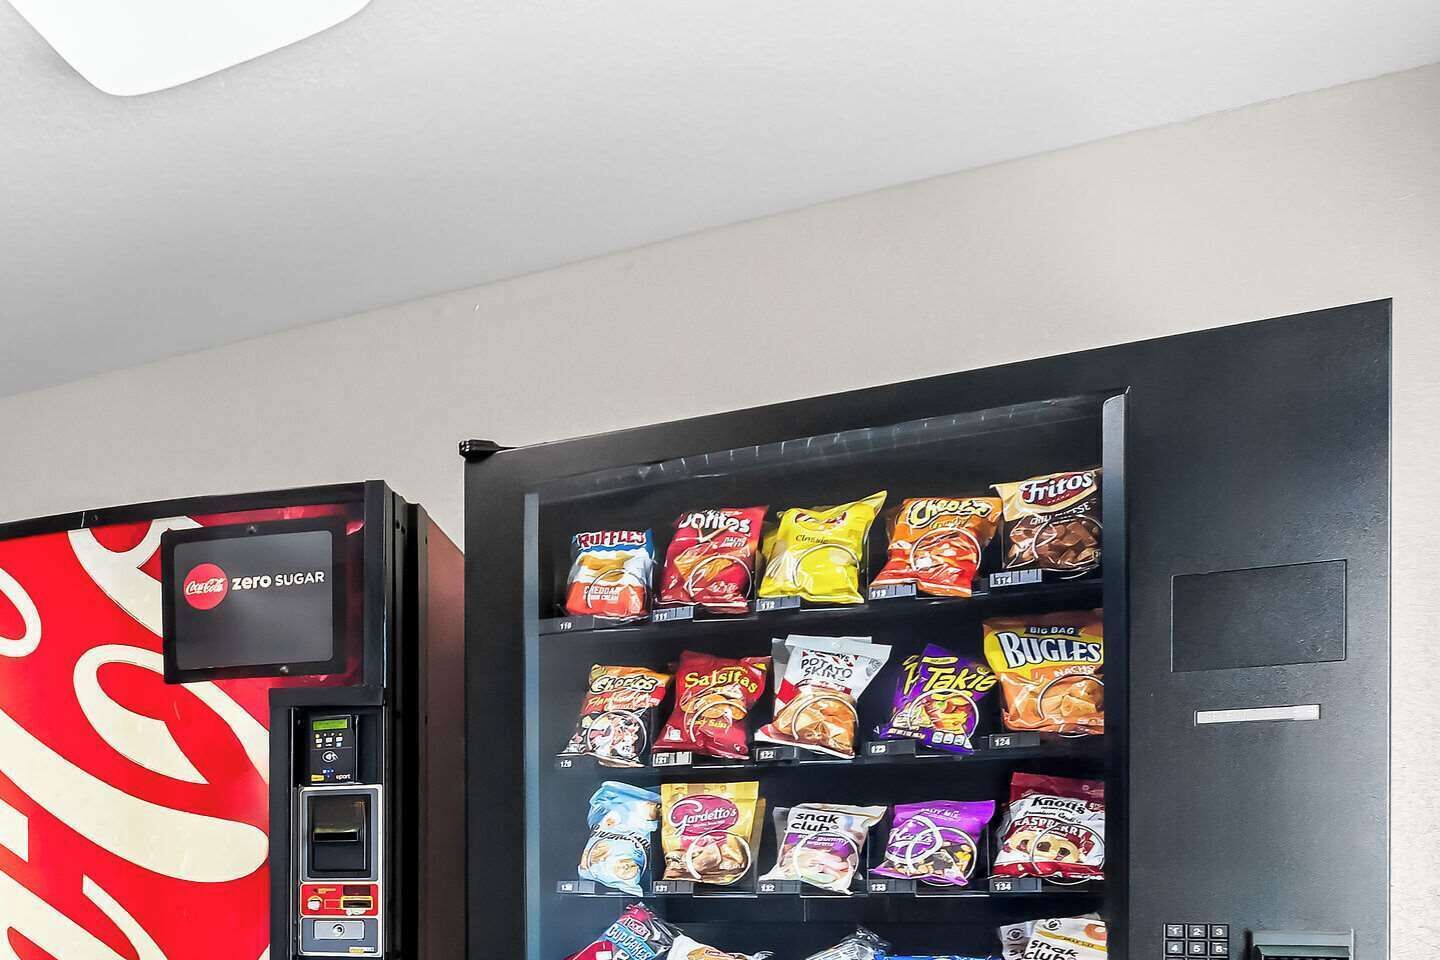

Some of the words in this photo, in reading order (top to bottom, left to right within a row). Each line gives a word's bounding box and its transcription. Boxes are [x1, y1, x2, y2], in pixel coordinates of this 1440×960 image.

[1019, 472, 1094, 503] Fritos
[576, 530, 647, 549] RUFFLES
[231, 574, 272, 590] zero
[274, 571, 325, 587] SUGAR
[1030, 626, 1048, 634] BIG
[1050, 626, 1075, 635] BAG
[998, 632, 1102, 669] BUGLES
[801, 658, 853, 679] POTATO
[684, 667, 759, 693] Salsitas
[922, 666, 999, 692] Takis
[995, 739, 1011, 747] 124
[1031, 797, 1086, 815] Knott's
[669, 800, 738, 836] Gardetto's
[790, 820, 831, 832] club
[795, 813, 841, 825] snak
[995, 883, 1012, 891] 134
[1030, 940, 1078, 958] snak
